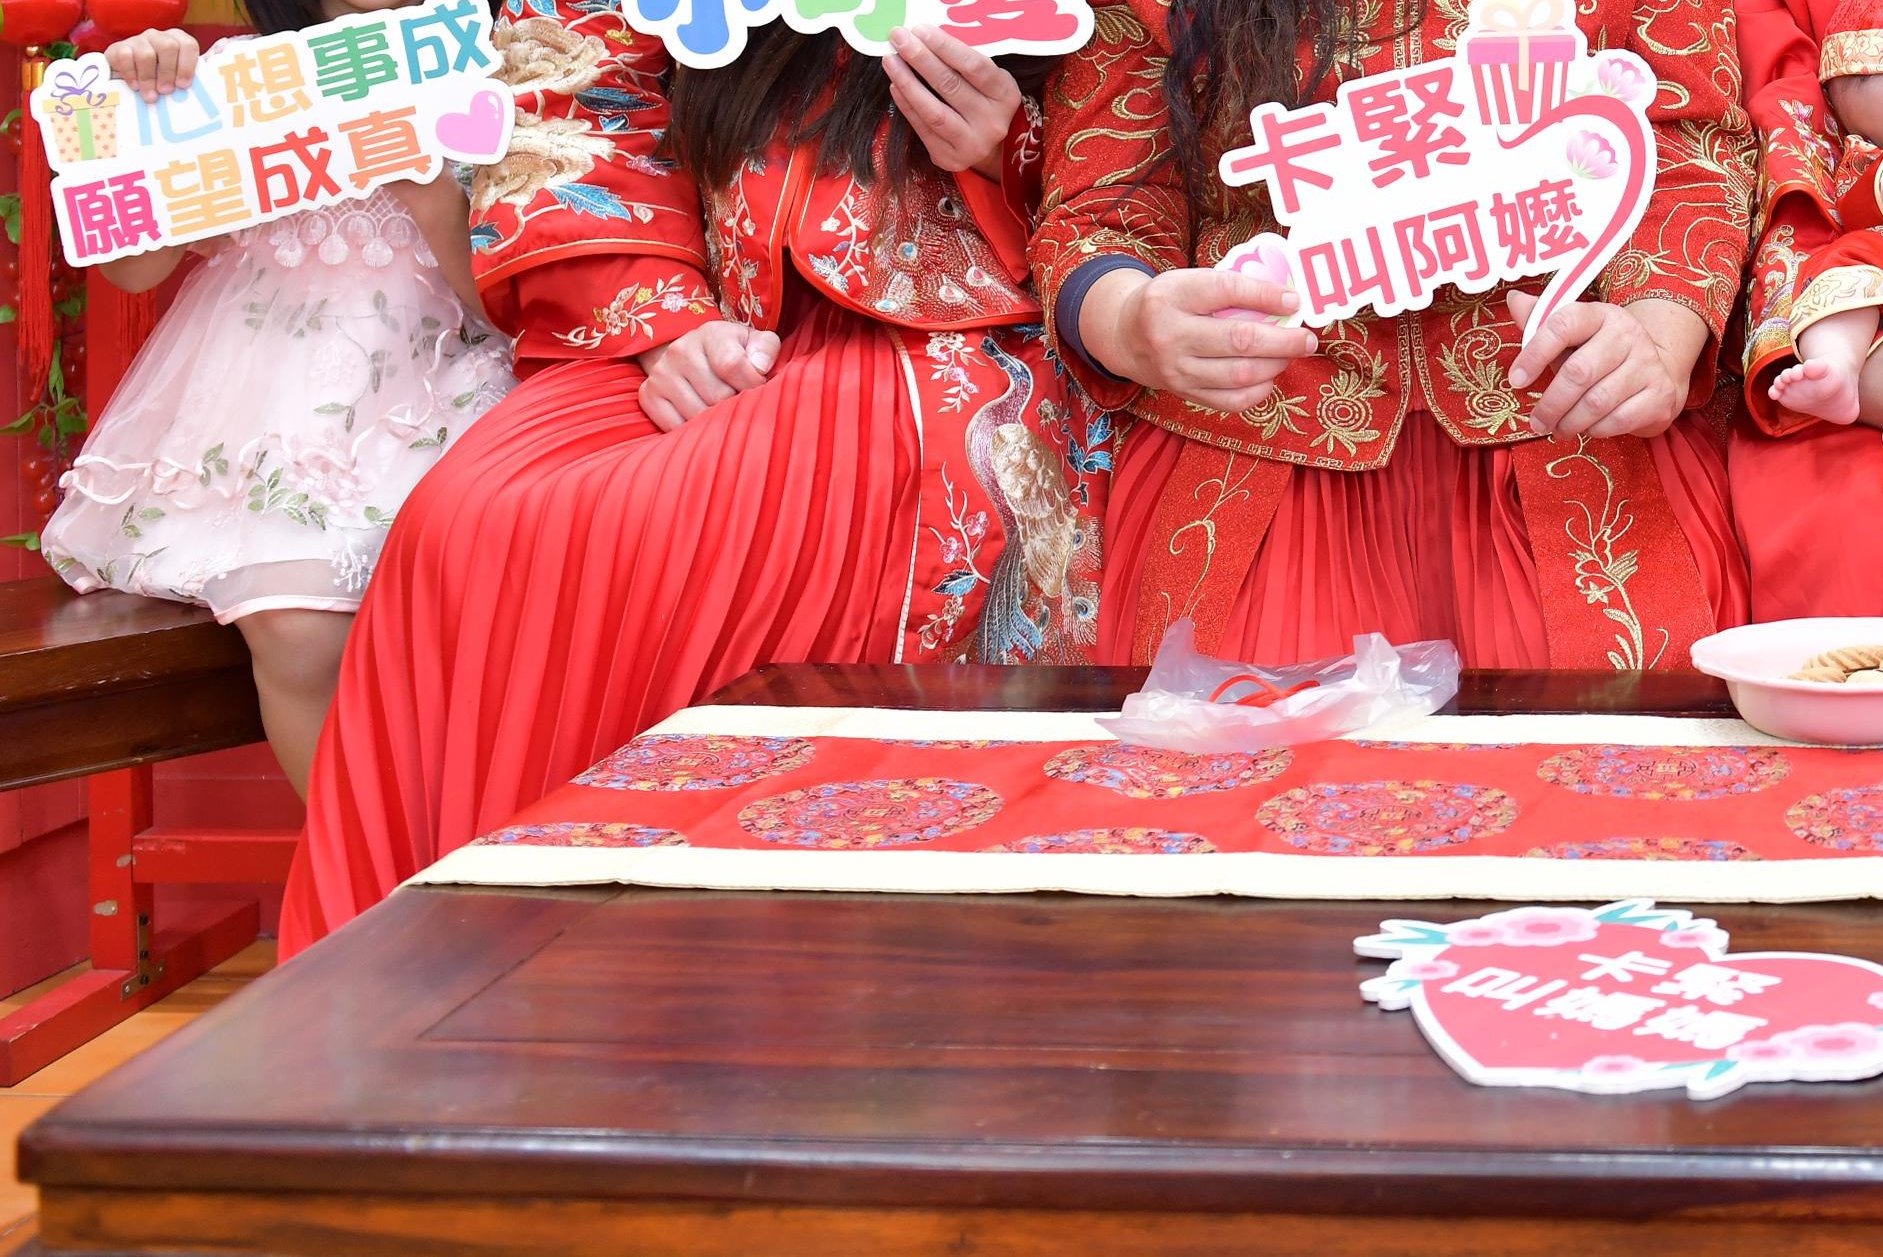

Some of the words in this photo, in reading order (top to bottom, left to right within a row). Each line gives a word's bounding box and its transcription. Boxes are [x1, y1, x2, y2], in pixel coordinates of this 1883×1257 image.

[62, 105, 432, 258] 願望成真
[1231, 67, 1471, 214] 卡緊
[1299, 178, 1590, 315] 叫阿嬤
